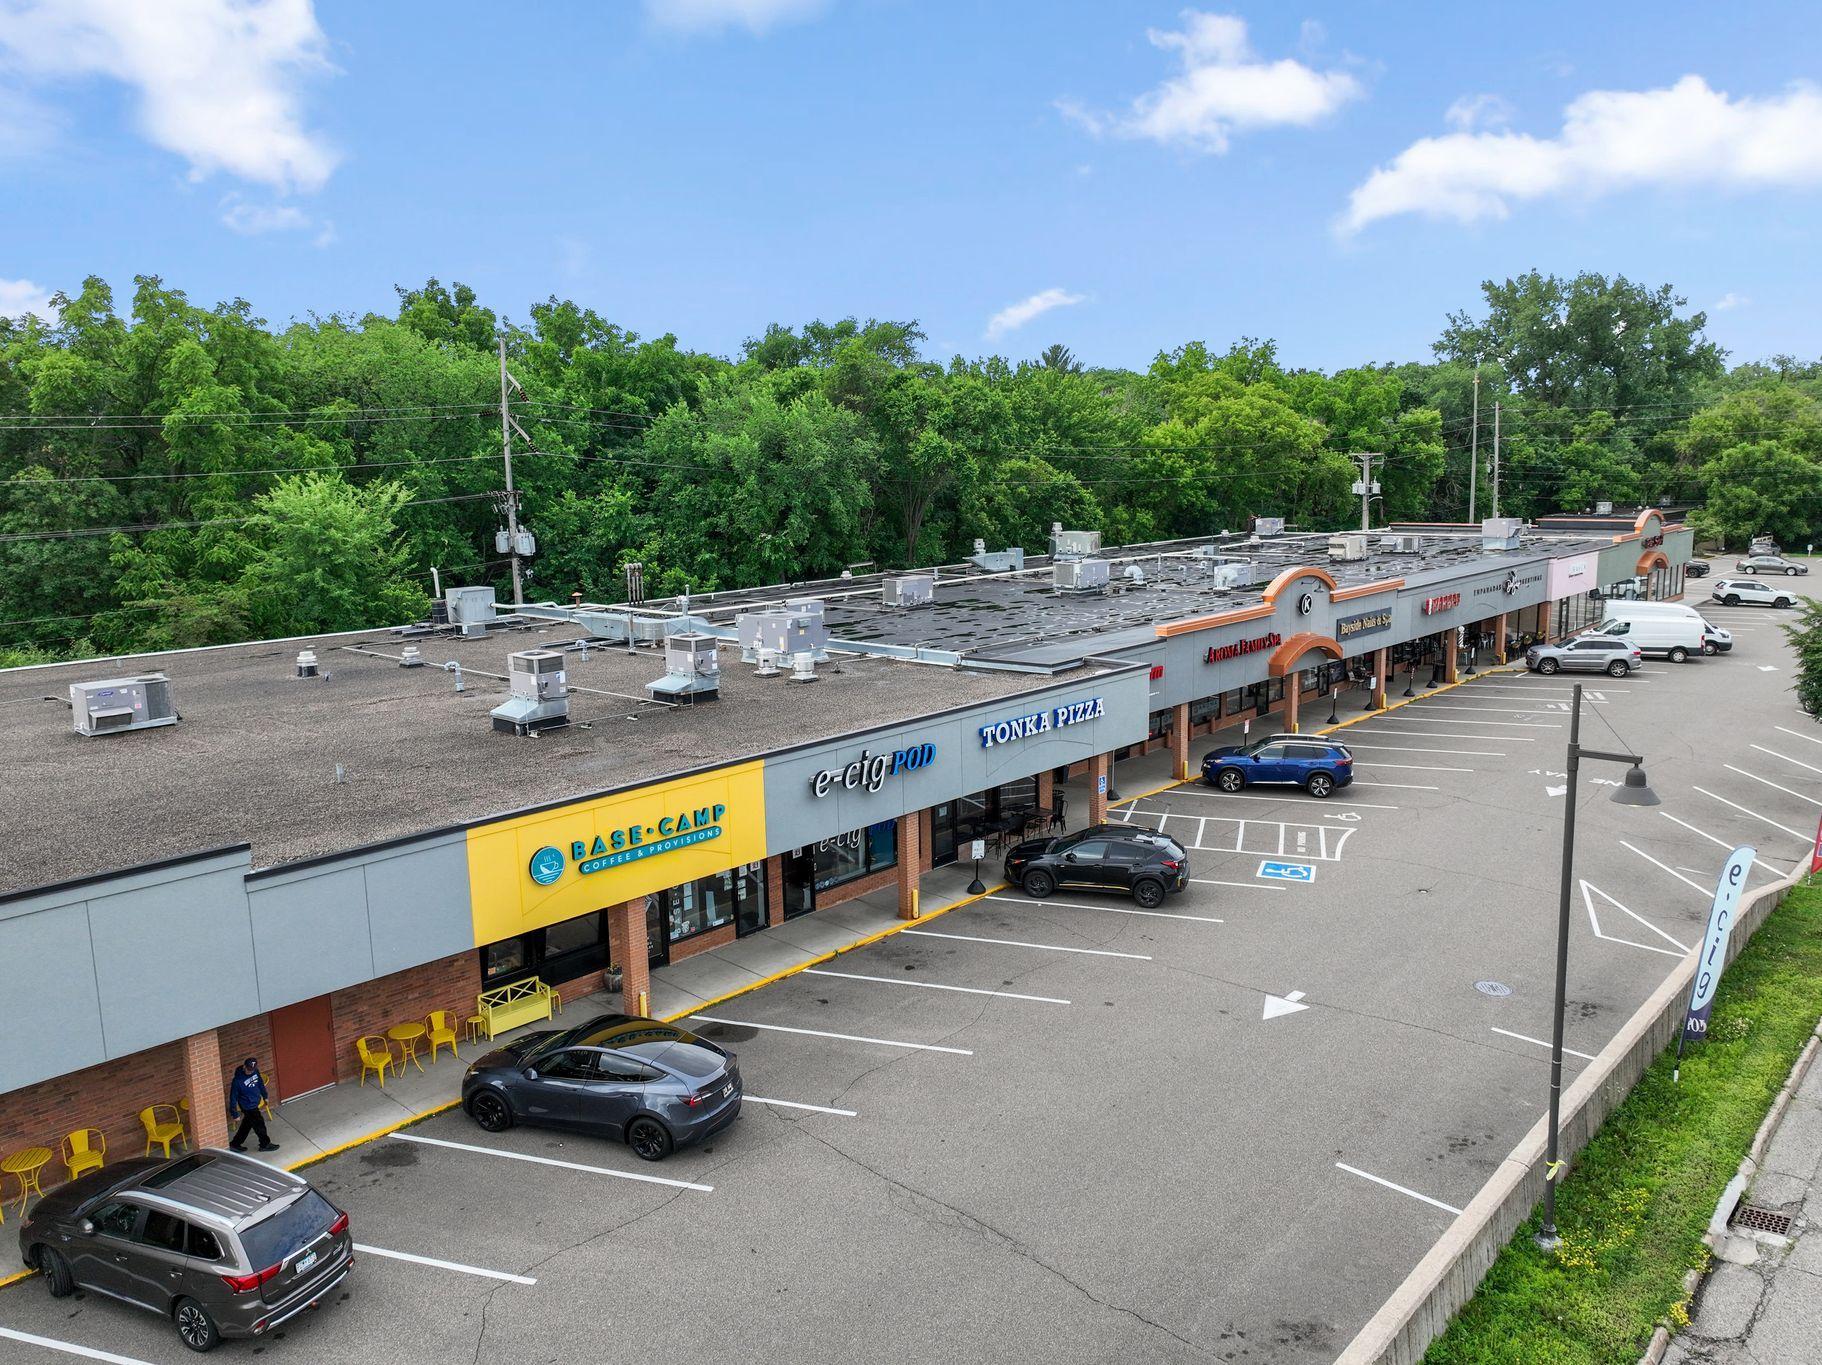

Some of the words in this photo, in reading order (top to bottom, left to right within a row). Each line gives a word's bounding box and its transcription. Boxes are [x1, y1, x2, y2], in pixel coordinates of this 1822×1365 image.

[1341, 618, 1361, 635] Bayside
[1363, 617, 1377, 629] Nails
[1382, 613, 1392, 626] Spa
[978, 712, 1050, 748] TONKA
[1053, 697, 1106, 728] PIZZA
[811, 750, 888, 798] e-cig
[889, 743, 937, 776] POD
[571, 825, 643, 860] BASE
[659, 804, 726, 836] CAMP
[583, 852, 631, 872] COFFEE
[637, 849, 644, 858] &
[649, 827, 721, 854] PROVISIONS
